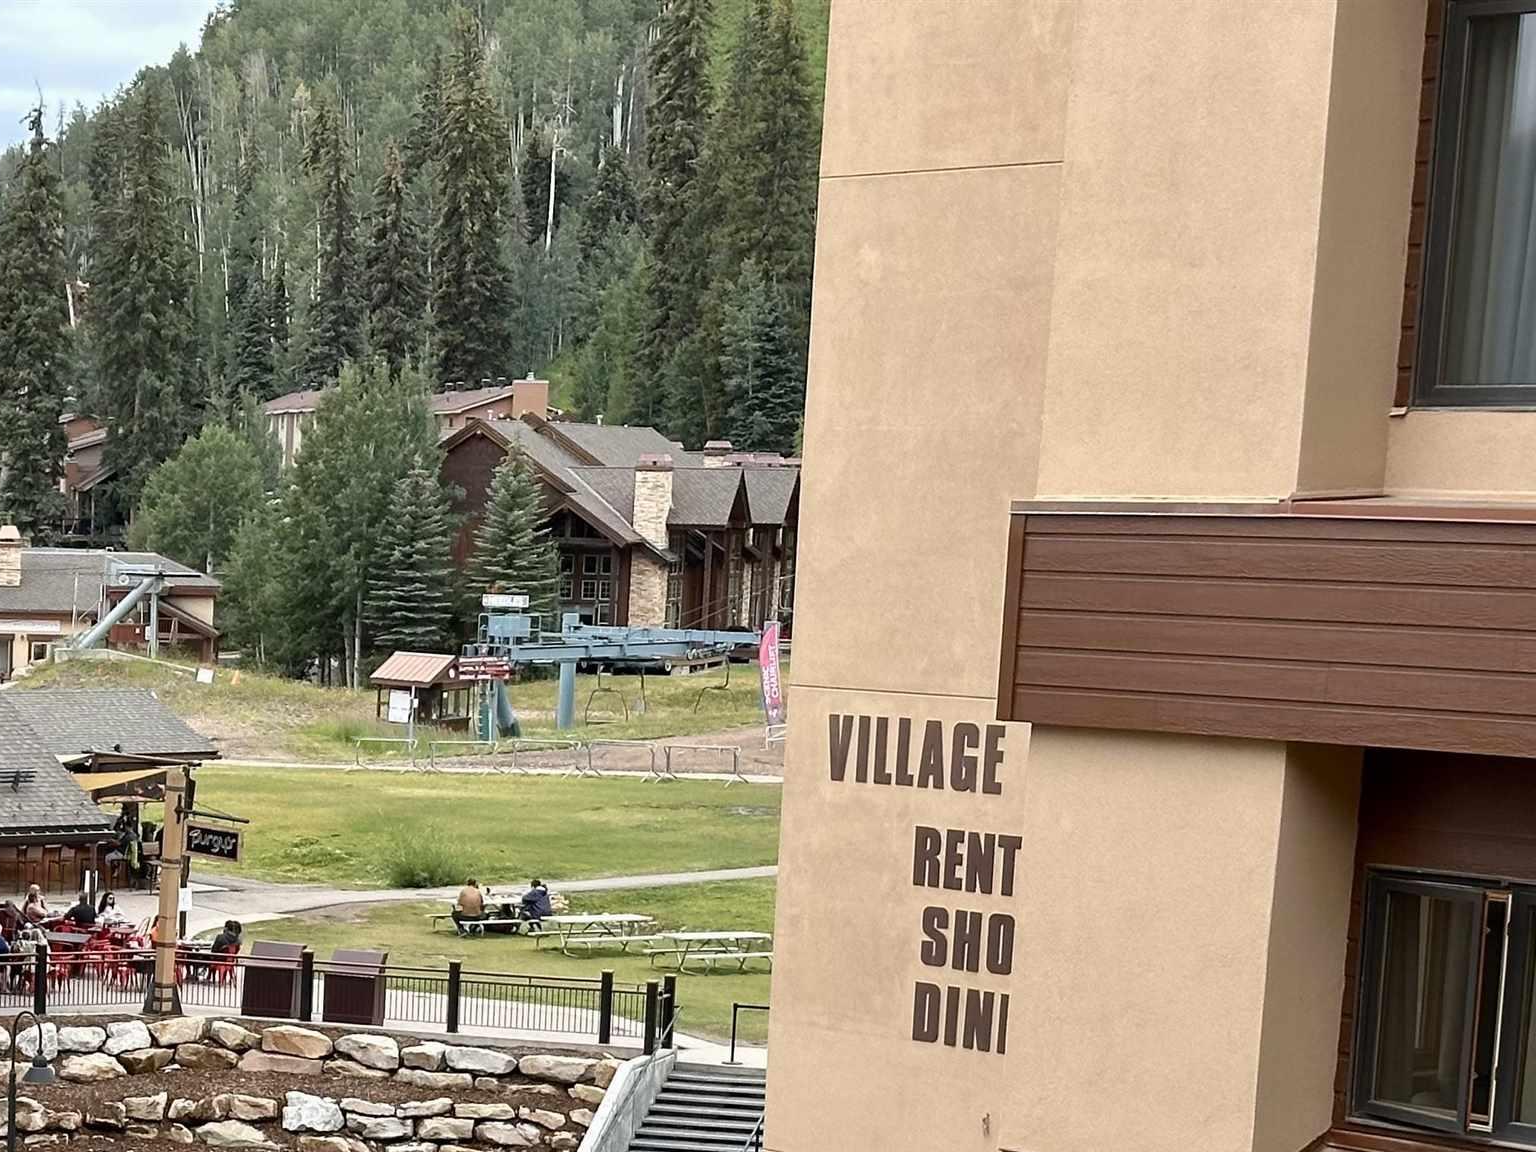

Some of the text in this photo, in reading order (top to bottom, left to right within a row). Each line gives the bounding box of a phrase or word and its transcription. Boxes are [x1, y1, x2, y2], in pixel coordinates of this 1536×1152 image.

[828, 713, 1006, 795] VILLAGE
[912, 825, 1023, 896] RENT
[920, 905, 1016, 975] SHO
[912, 981, 1010, 1054] DINI
